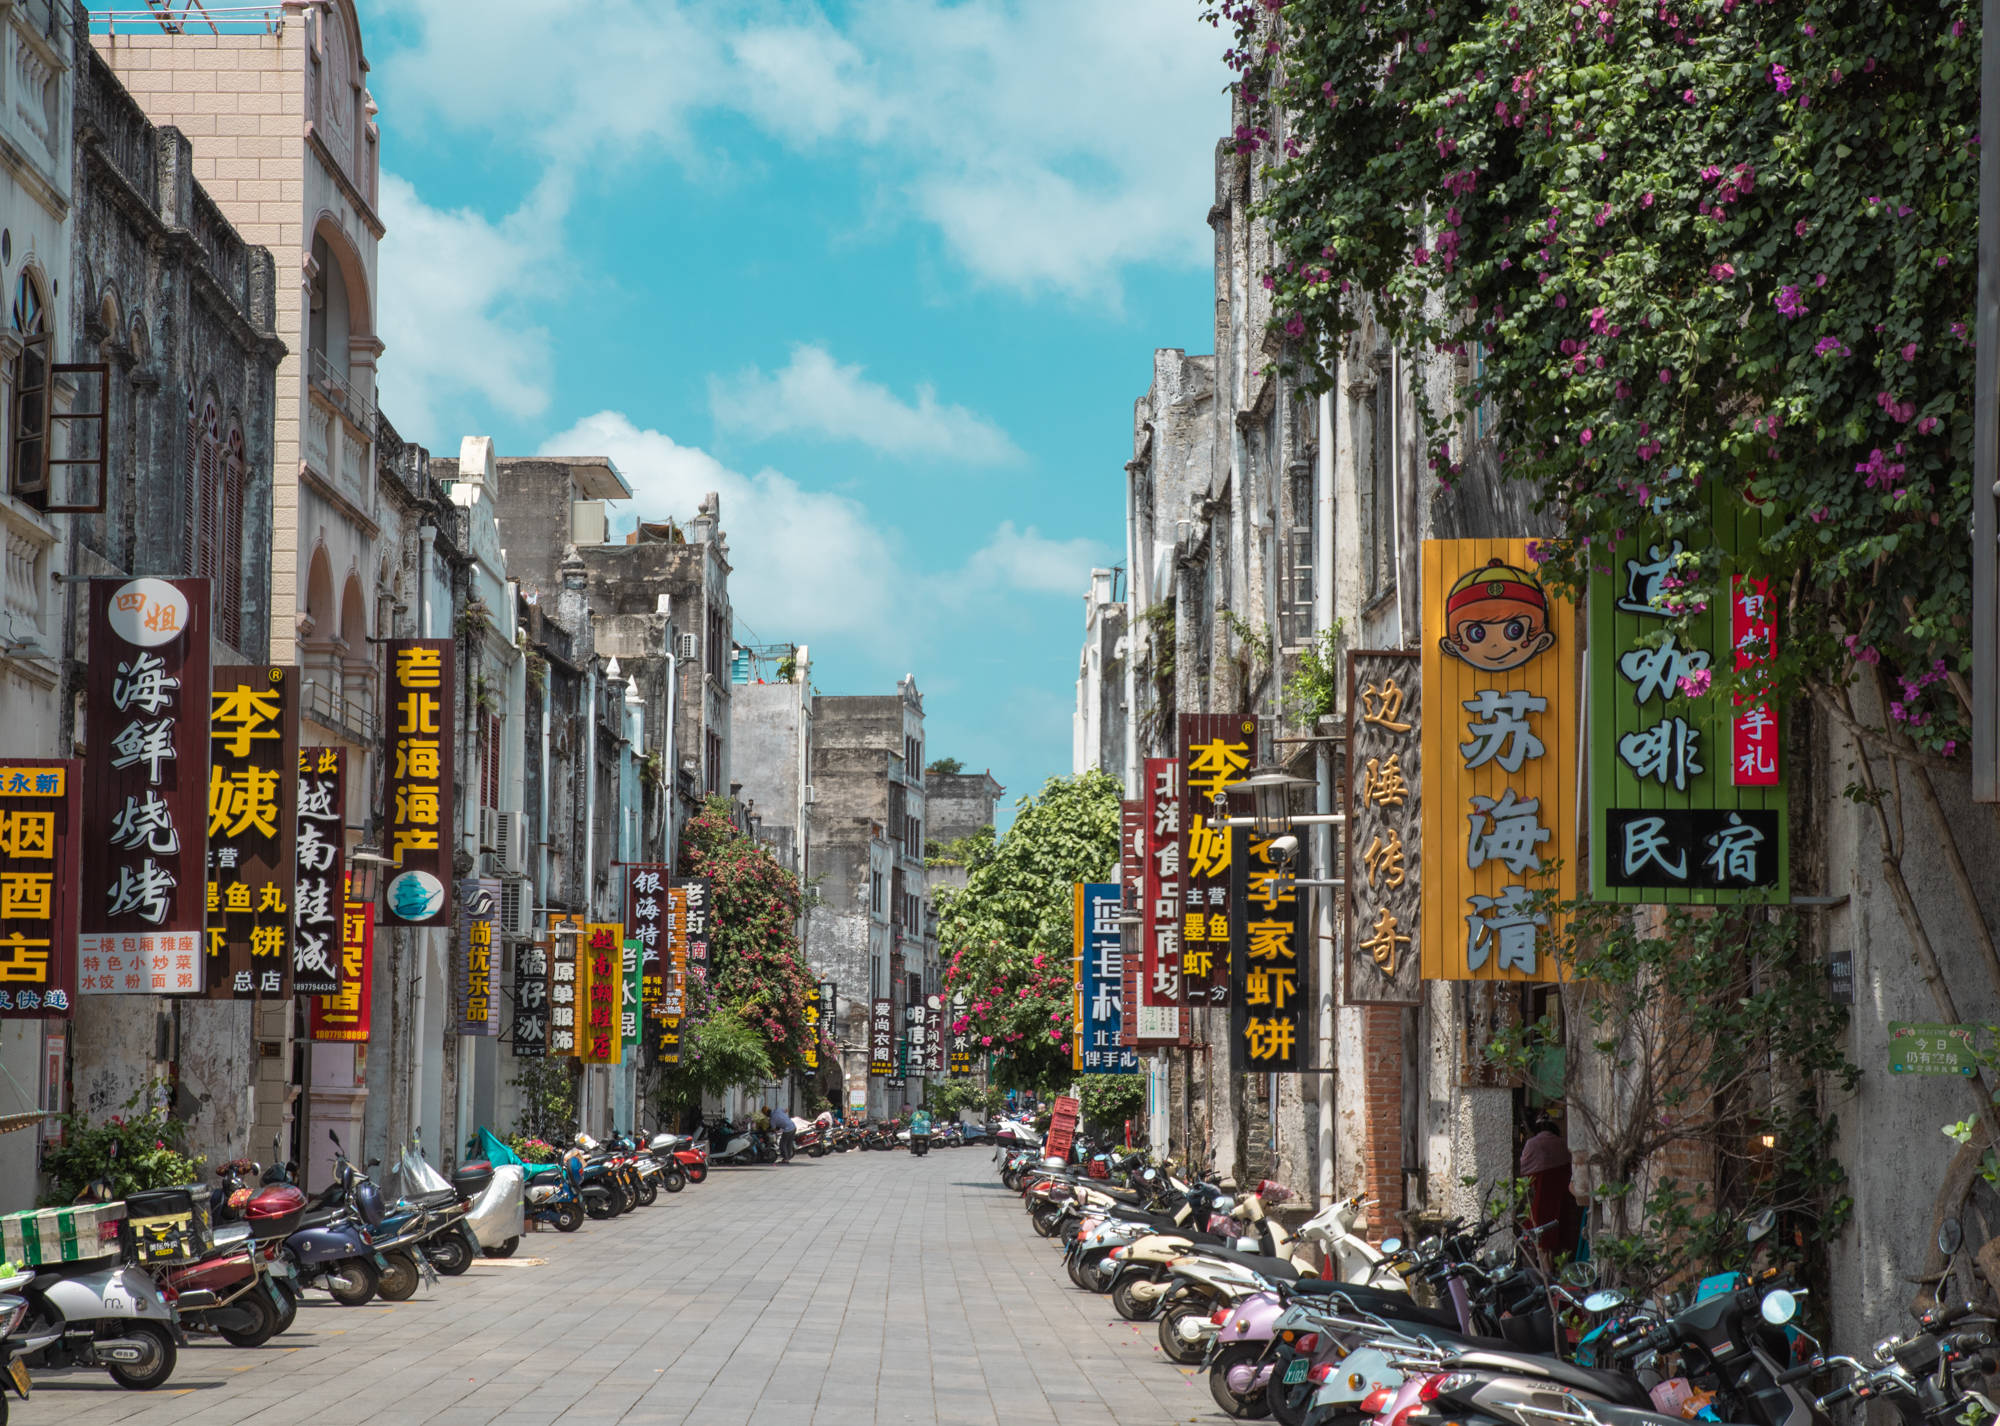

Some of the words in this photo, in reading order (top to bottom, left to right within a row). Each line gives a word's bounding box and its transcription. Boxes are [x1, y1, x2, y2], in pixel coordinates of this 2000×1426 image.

[116, 592, 181, 633] 四姐
[0, 773, 59, 794] 永新
[107, 651, 180, 925] 海鲜烧烤
[209, 684, 281, 839] 李姨
[394, 646, 441, 868] 老北海海产
[1187, 738, 1249, 879] 李姨
[1360, 677, 1412, 977] 边陲传奇
[1460, 689, 1551, 975] 苏海清
[1623, 812, 1766, 882] 民宿
[296, 781, 341, 980] 越南鞋城
[633, 871, 664, 966] 银海特产
[1186, 888, 1226, 905] 主营
[81, 974, 115, 990] 水饺
[125, 973, 141, 989] 粉
[151, 973, 167, 988] 面
[177, 972, 193, 988] 粥
[83, 938, 115, 953] 二楼
[122, 936, 154, 952] 包厢
[160, 935, 193, 951] 雅座
[83, 955, 193, 971] 特色小炒菜
[233, 970, 281, 992] 总店
[466, 921, 492, 1023] 尚优乐品
[1183, 950, 1231, 978] 虾
[588, 928, 617, 1059] 越南潮鞋店
[1915, 1038, 1947, 1050] 今日
